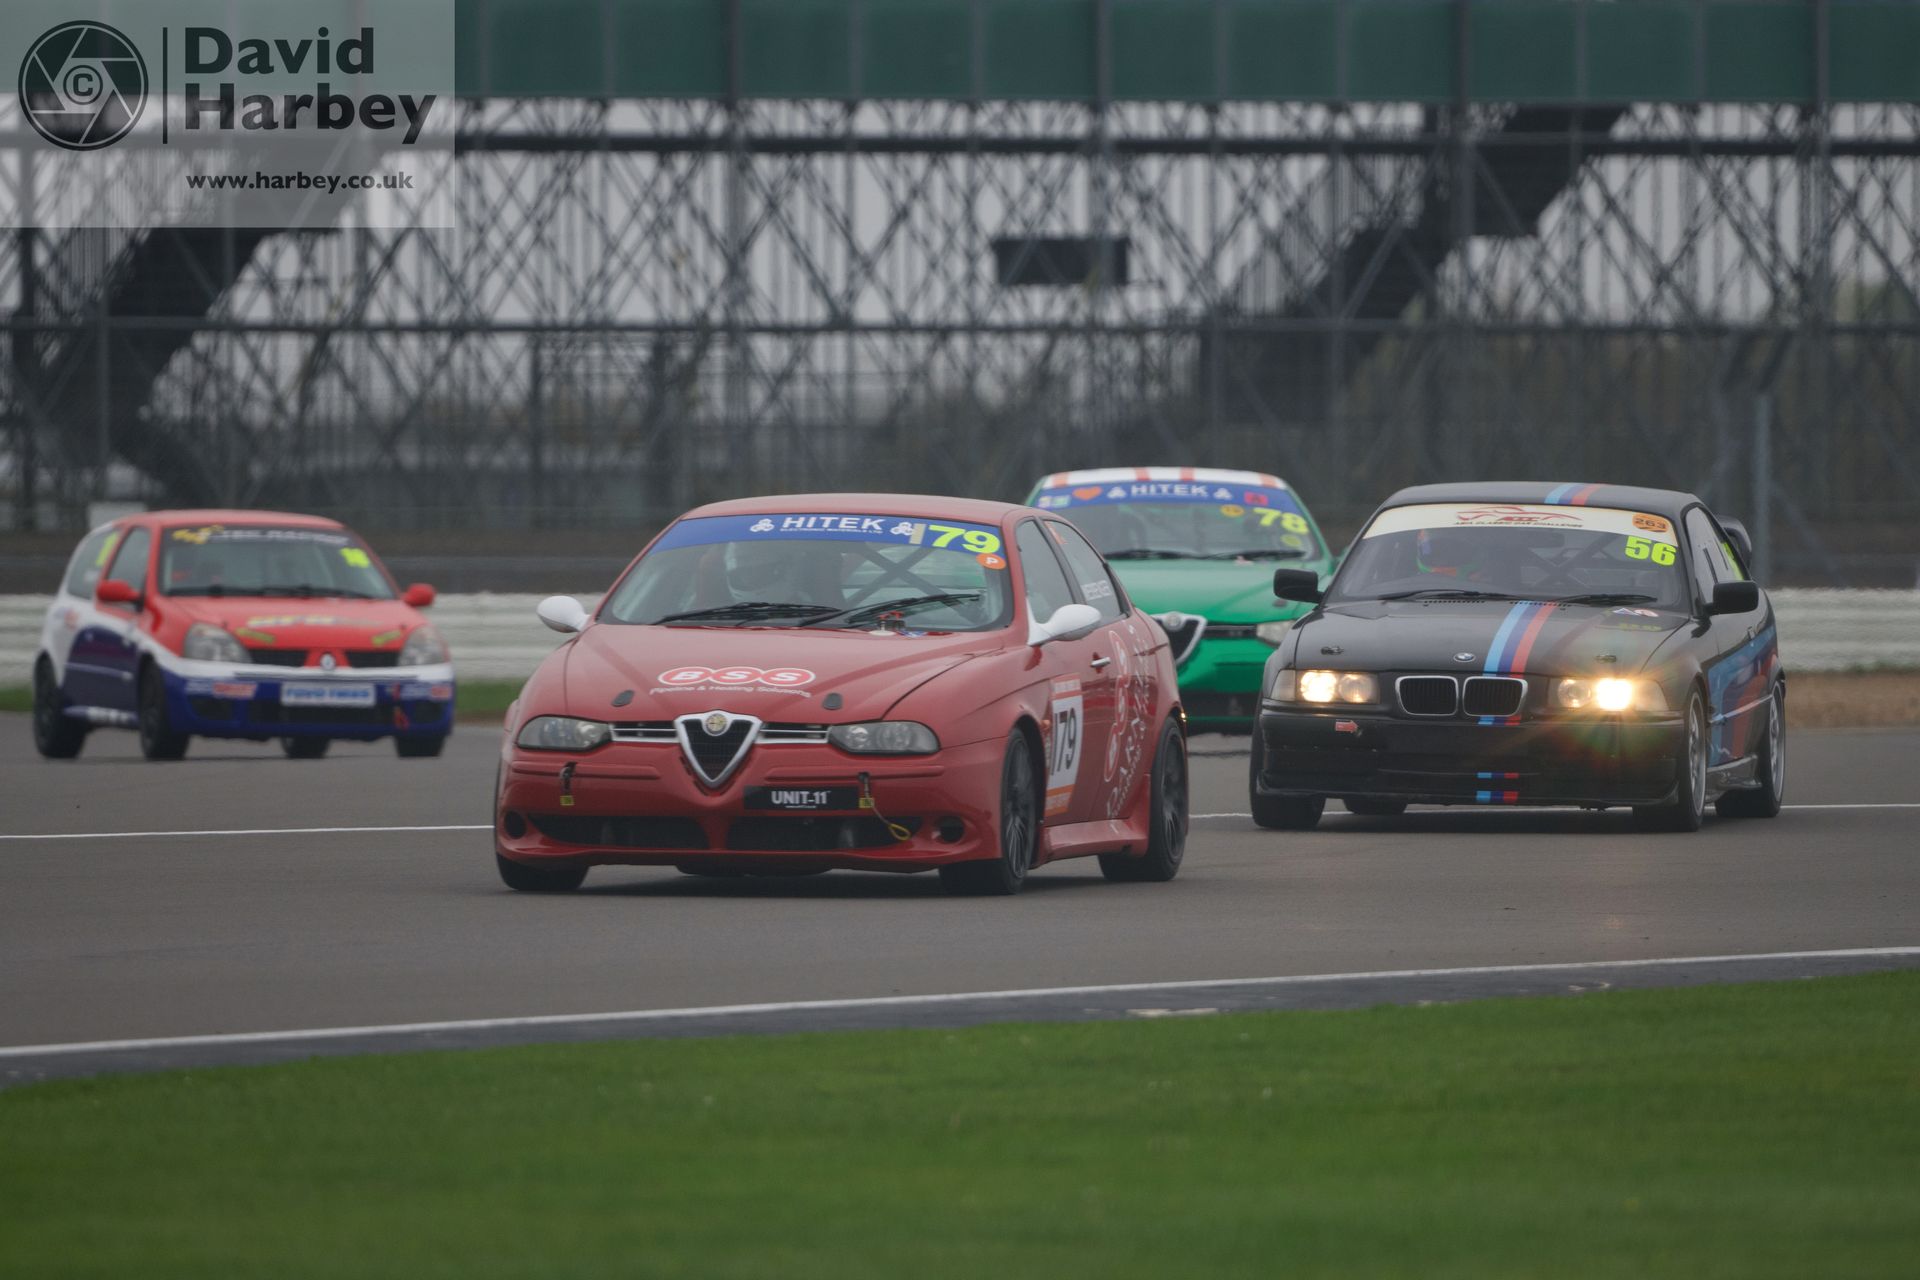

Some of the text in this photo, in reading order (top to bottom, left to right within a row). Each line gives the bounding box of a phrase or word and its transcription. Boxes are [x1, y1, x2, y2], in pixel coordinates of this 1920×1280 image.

[1131, 484, 1208, 496] HITEK
[782, 517, 885, 530] HITEK
[1253, 507, 1309, 534] 78
[1625, 535, 1676, 566] 56
